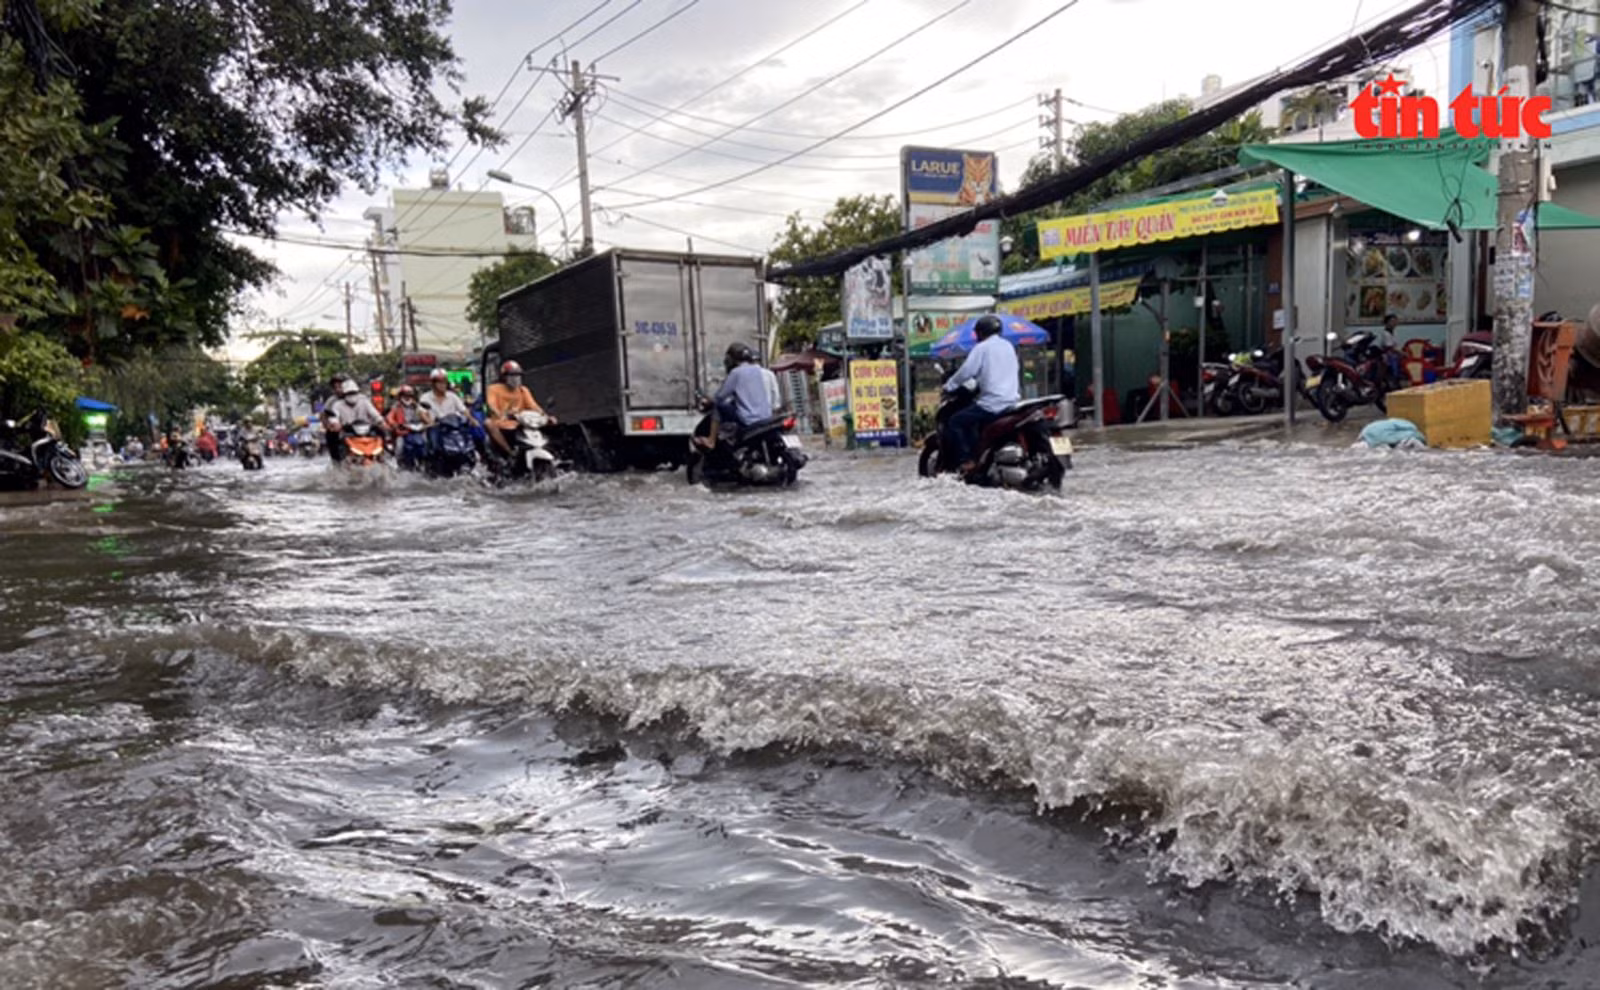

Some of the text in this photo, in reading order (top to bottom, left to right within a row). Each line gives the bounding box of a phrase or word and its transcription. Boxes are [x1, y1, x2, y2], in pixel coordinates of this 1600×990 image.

[911, 160, 961, 174] LARUE
[1064, 217, 1102, 247] MIỀN
[1104, 212, 1134, 241] TÂY
[1135, 206, 1177, 240] QUÁN
[857, 414, 880, 429] 25K
